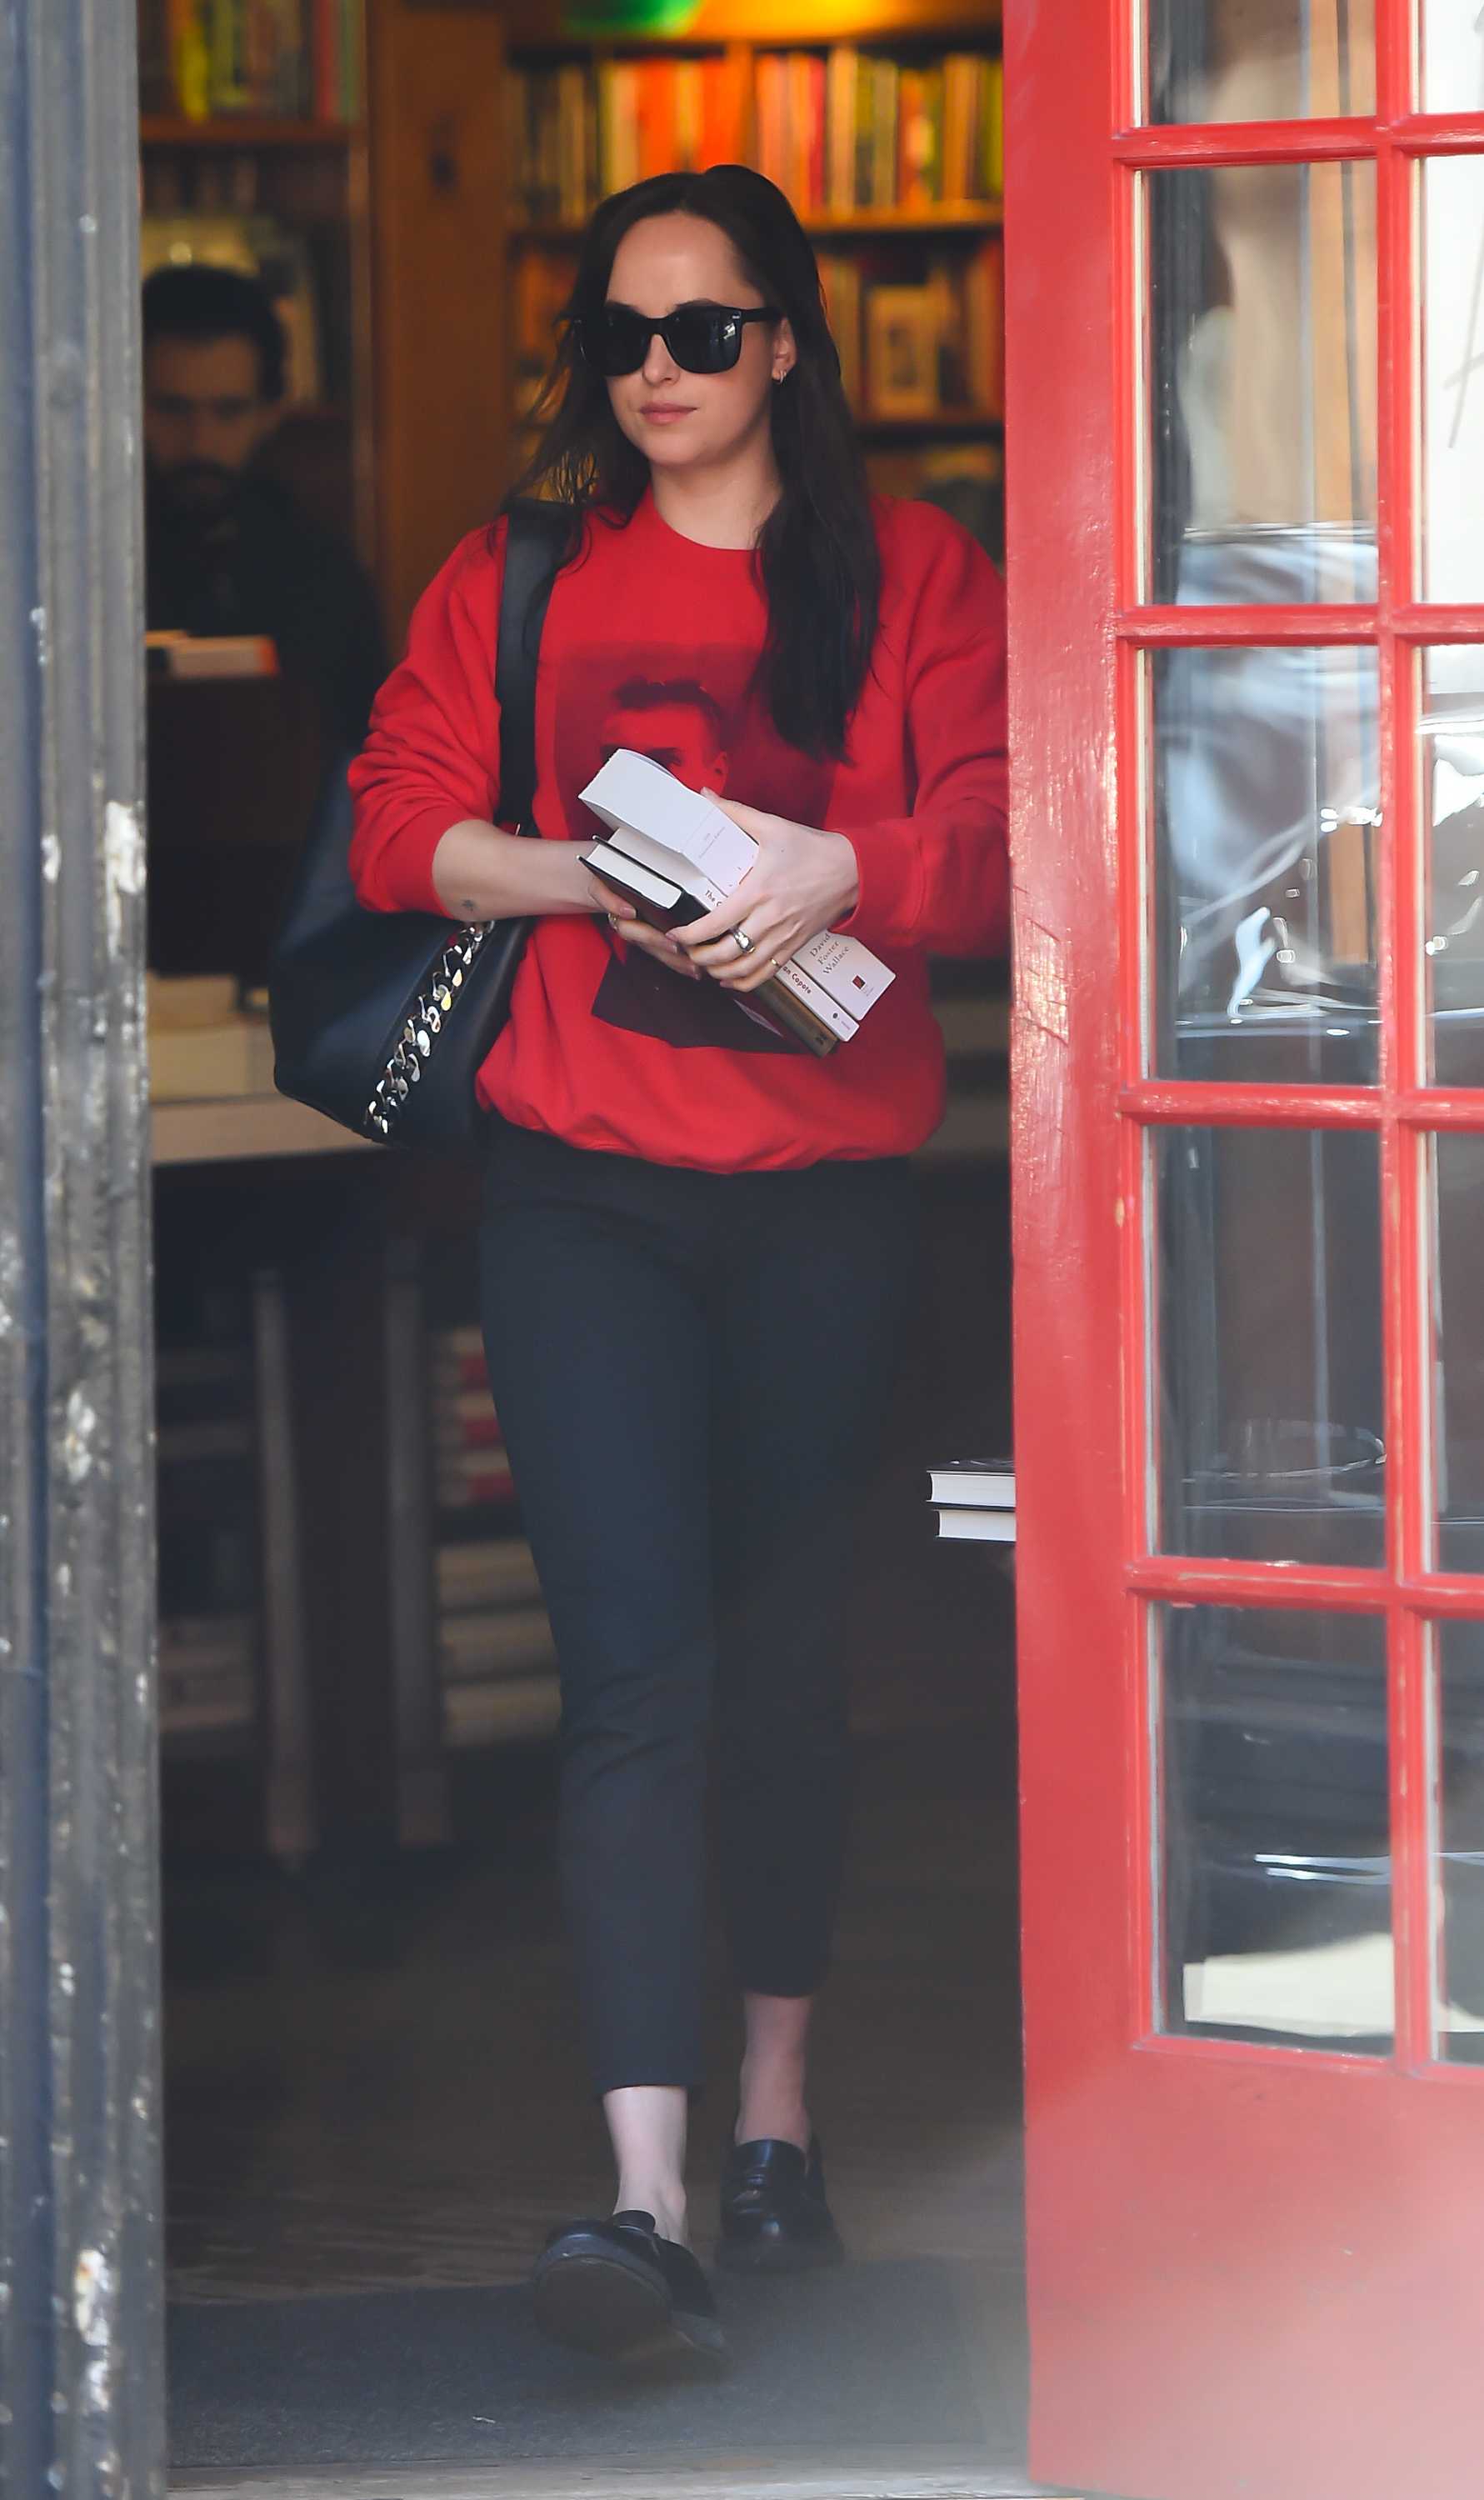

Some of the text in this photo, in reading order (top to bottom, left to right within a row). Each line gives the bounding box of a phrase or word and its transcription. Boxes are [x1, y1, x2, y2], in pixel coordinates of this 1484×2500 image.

[705, 890, 716, 902] The
[810, 932, 831, 957] David
[817, 941, 840, 965] Foster
[822, 947, 850, 974] Wallace
[792, 973, 812, 994] Capote
